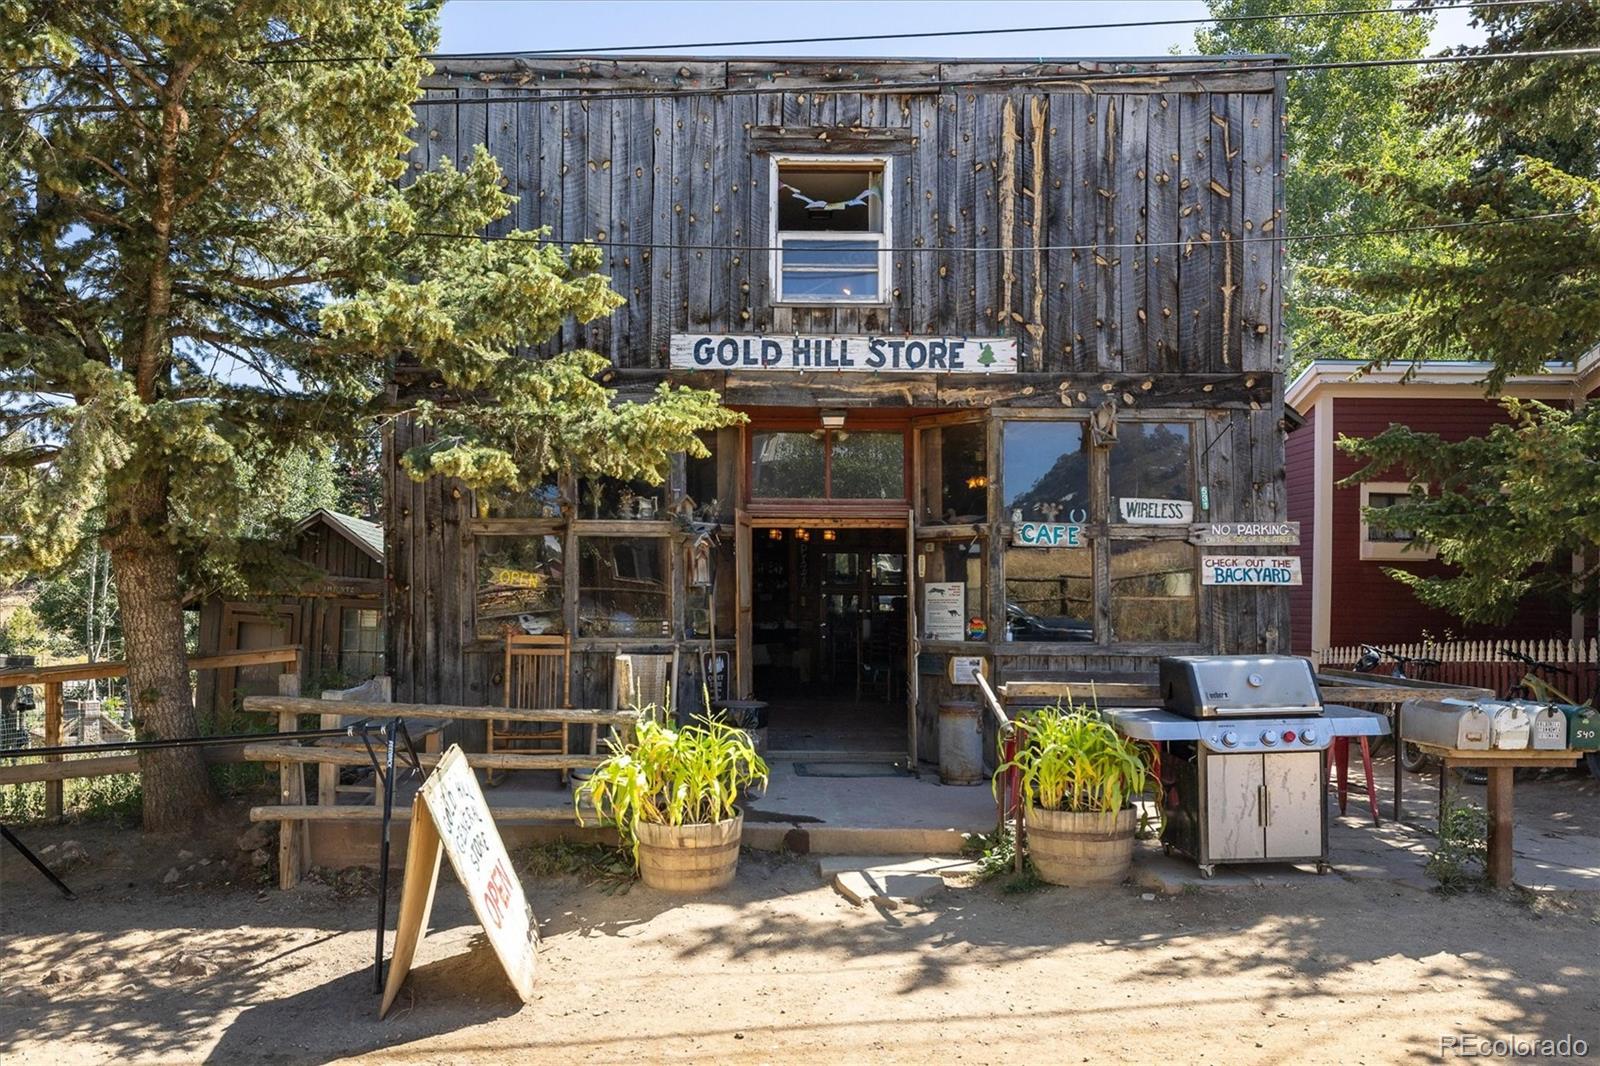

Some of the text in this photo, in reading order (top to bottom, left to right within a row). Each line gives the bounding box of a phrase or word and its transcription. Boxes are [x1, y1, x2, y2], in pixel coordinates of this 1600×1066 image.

[693, 337, 965, 369] GOLD HILL STORE
[1126, 501, 1184, 520] WIRELESS
[1021, 524, 1081, 545] CAFE
[1211, 524, 1290, 536] NO PARKING
[1205, 559, 1291, 568] CHECK OUT THE
[500, 570, 538, 588] OPEN
[1214, 567, 1292, 583] BACKYARD
[1576, 730, 1595, 739] 540
[470, 832, 490, 872] STORE
[484, 858, 515, 929] OPEN
